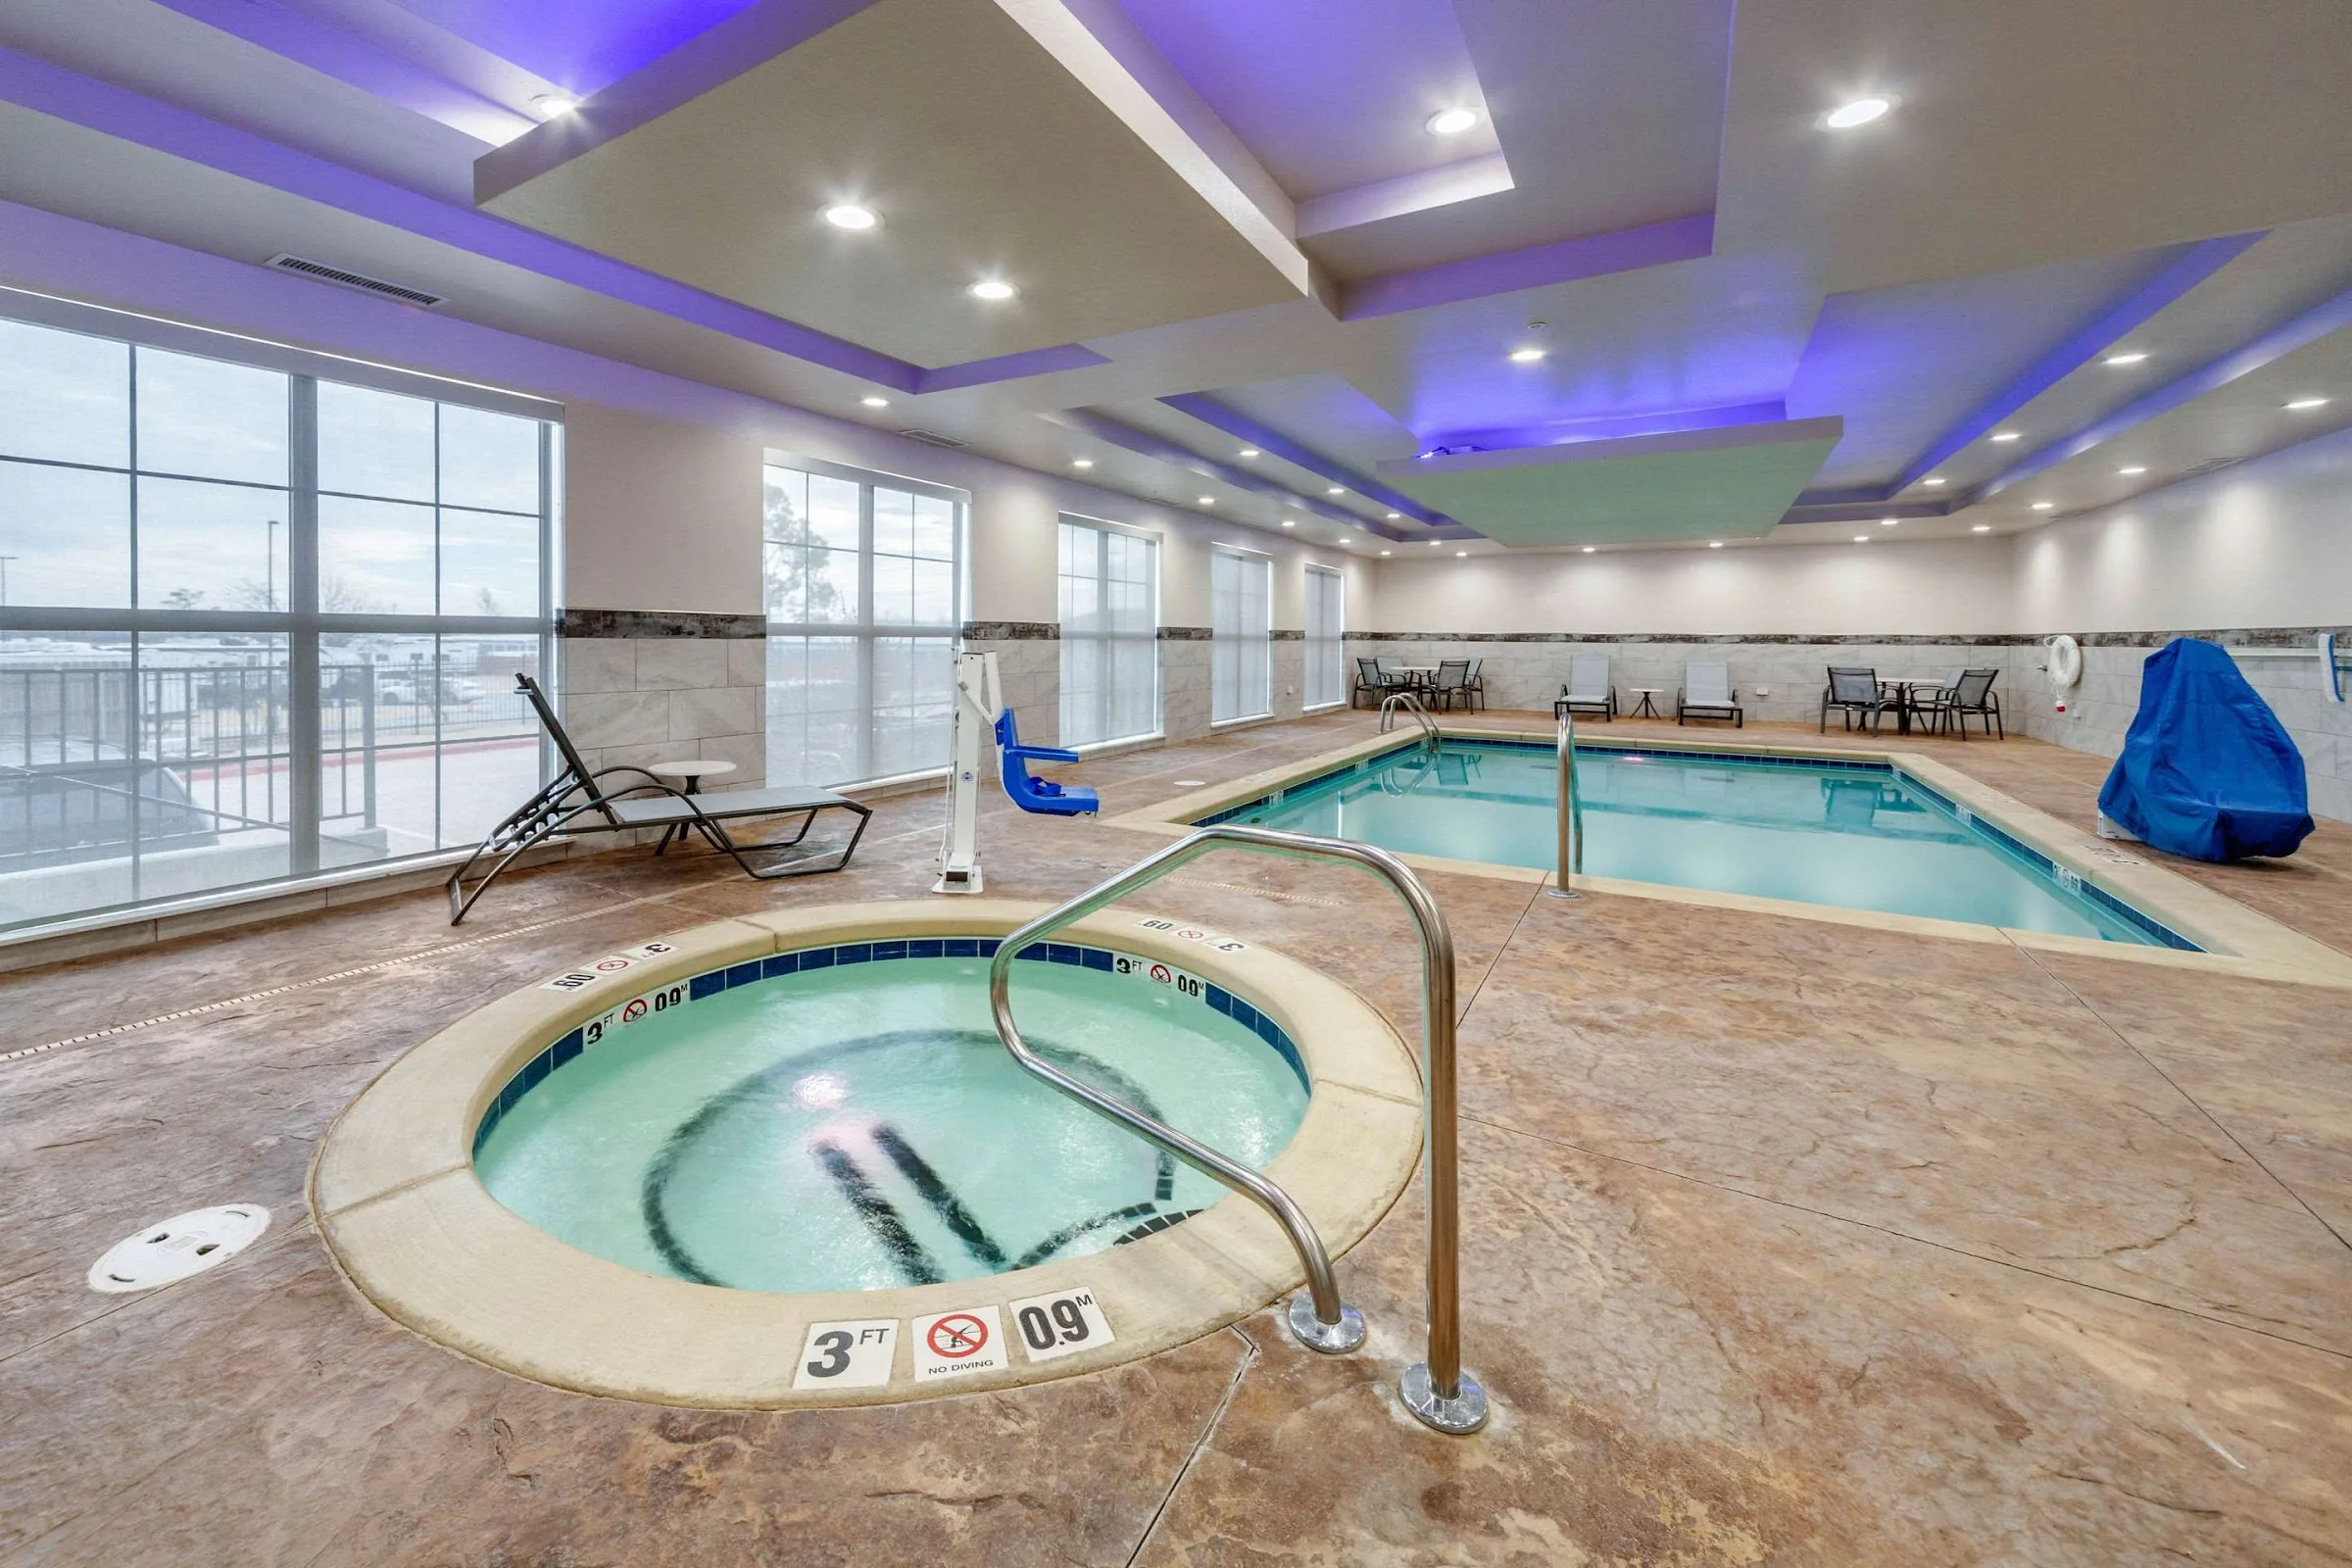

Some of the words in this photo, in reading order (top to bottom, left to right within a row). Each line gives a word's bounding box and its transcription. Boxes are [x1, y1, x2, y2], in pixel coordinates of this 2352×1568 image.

[645, 944, 671, 953] 3
[1116, 957, 1131, 973] 3
[1132, 959, 1143, 970] FT
[587, 1021, 603, 1045] 3
[604, 1012, 614, 1027] FT
[807, 1330, 855, 1378] 3
[859, 1328, 890, 1345] FT
[952, 1359, 994, 1371] DIVING
